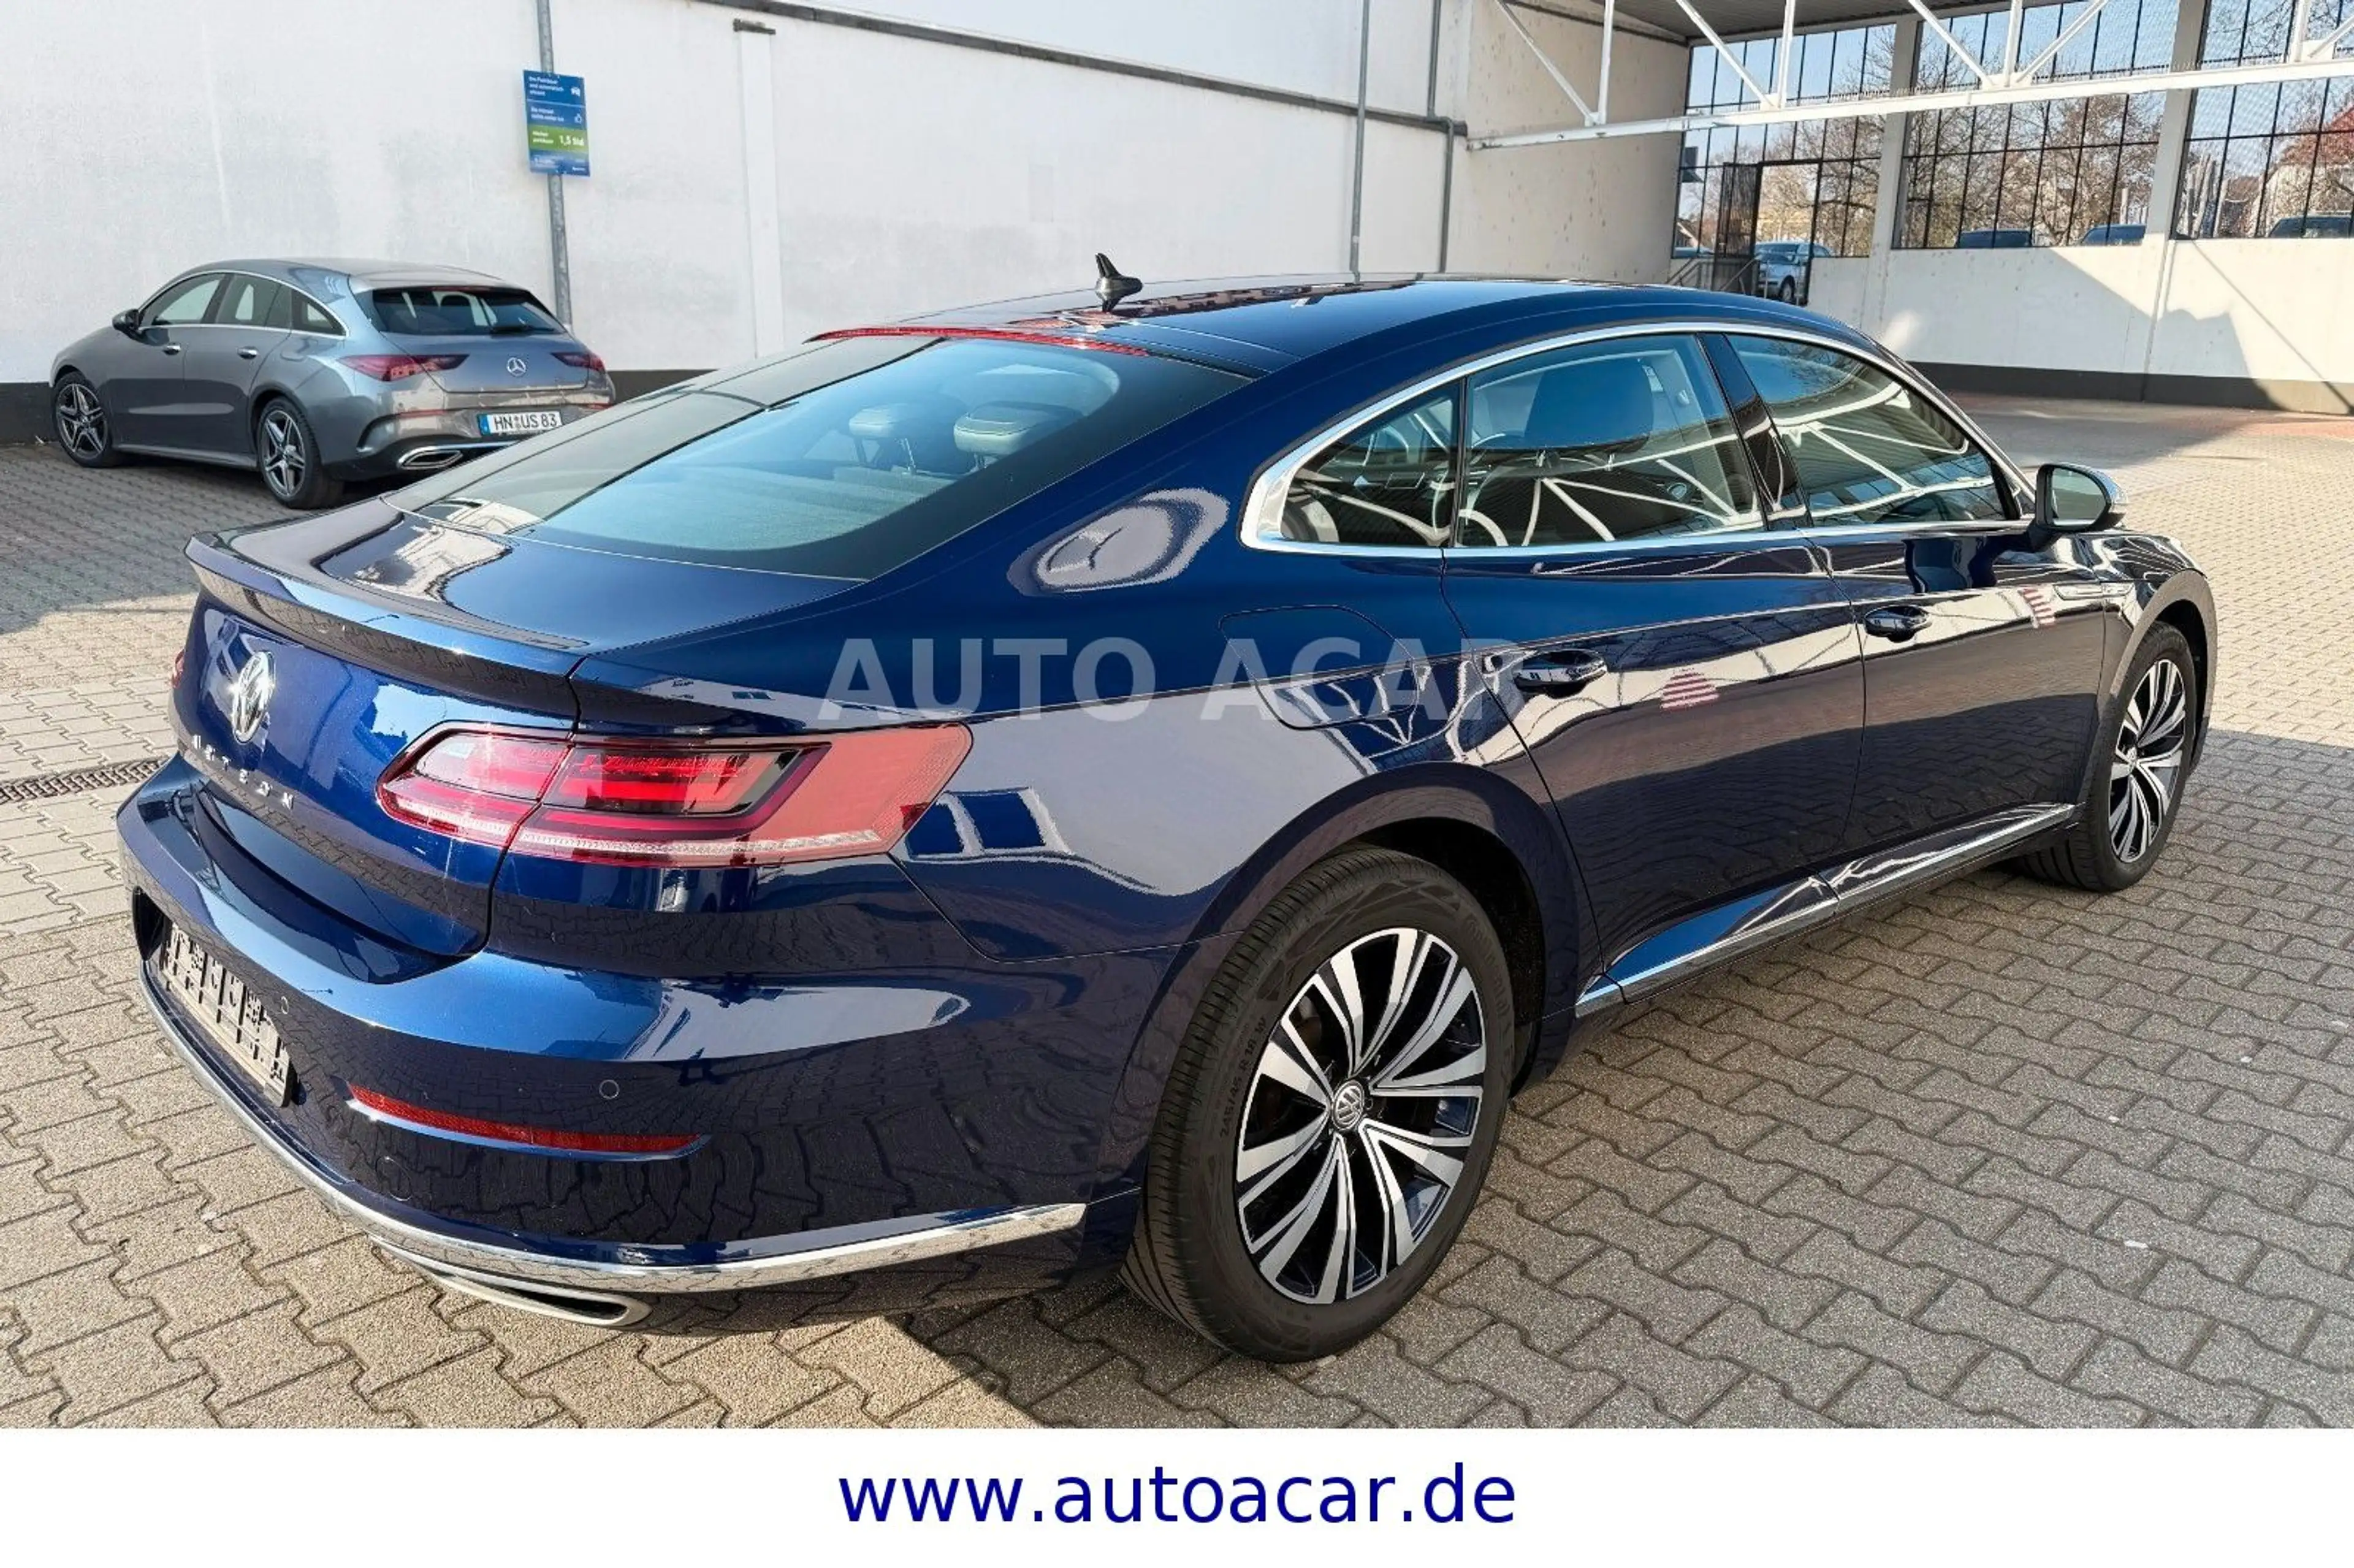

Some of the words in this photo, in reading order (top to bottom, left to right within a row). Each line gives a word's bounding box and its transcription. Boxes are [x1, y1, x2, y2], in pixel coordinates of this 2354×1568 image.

[493, 416, 512, 430] HN
[521, 414, 539, 428] US
[541, 413, 557, 427] 83
[1238, 1059, 1250, 1071] R
[1244, 1038, 1257, 1056] 18
